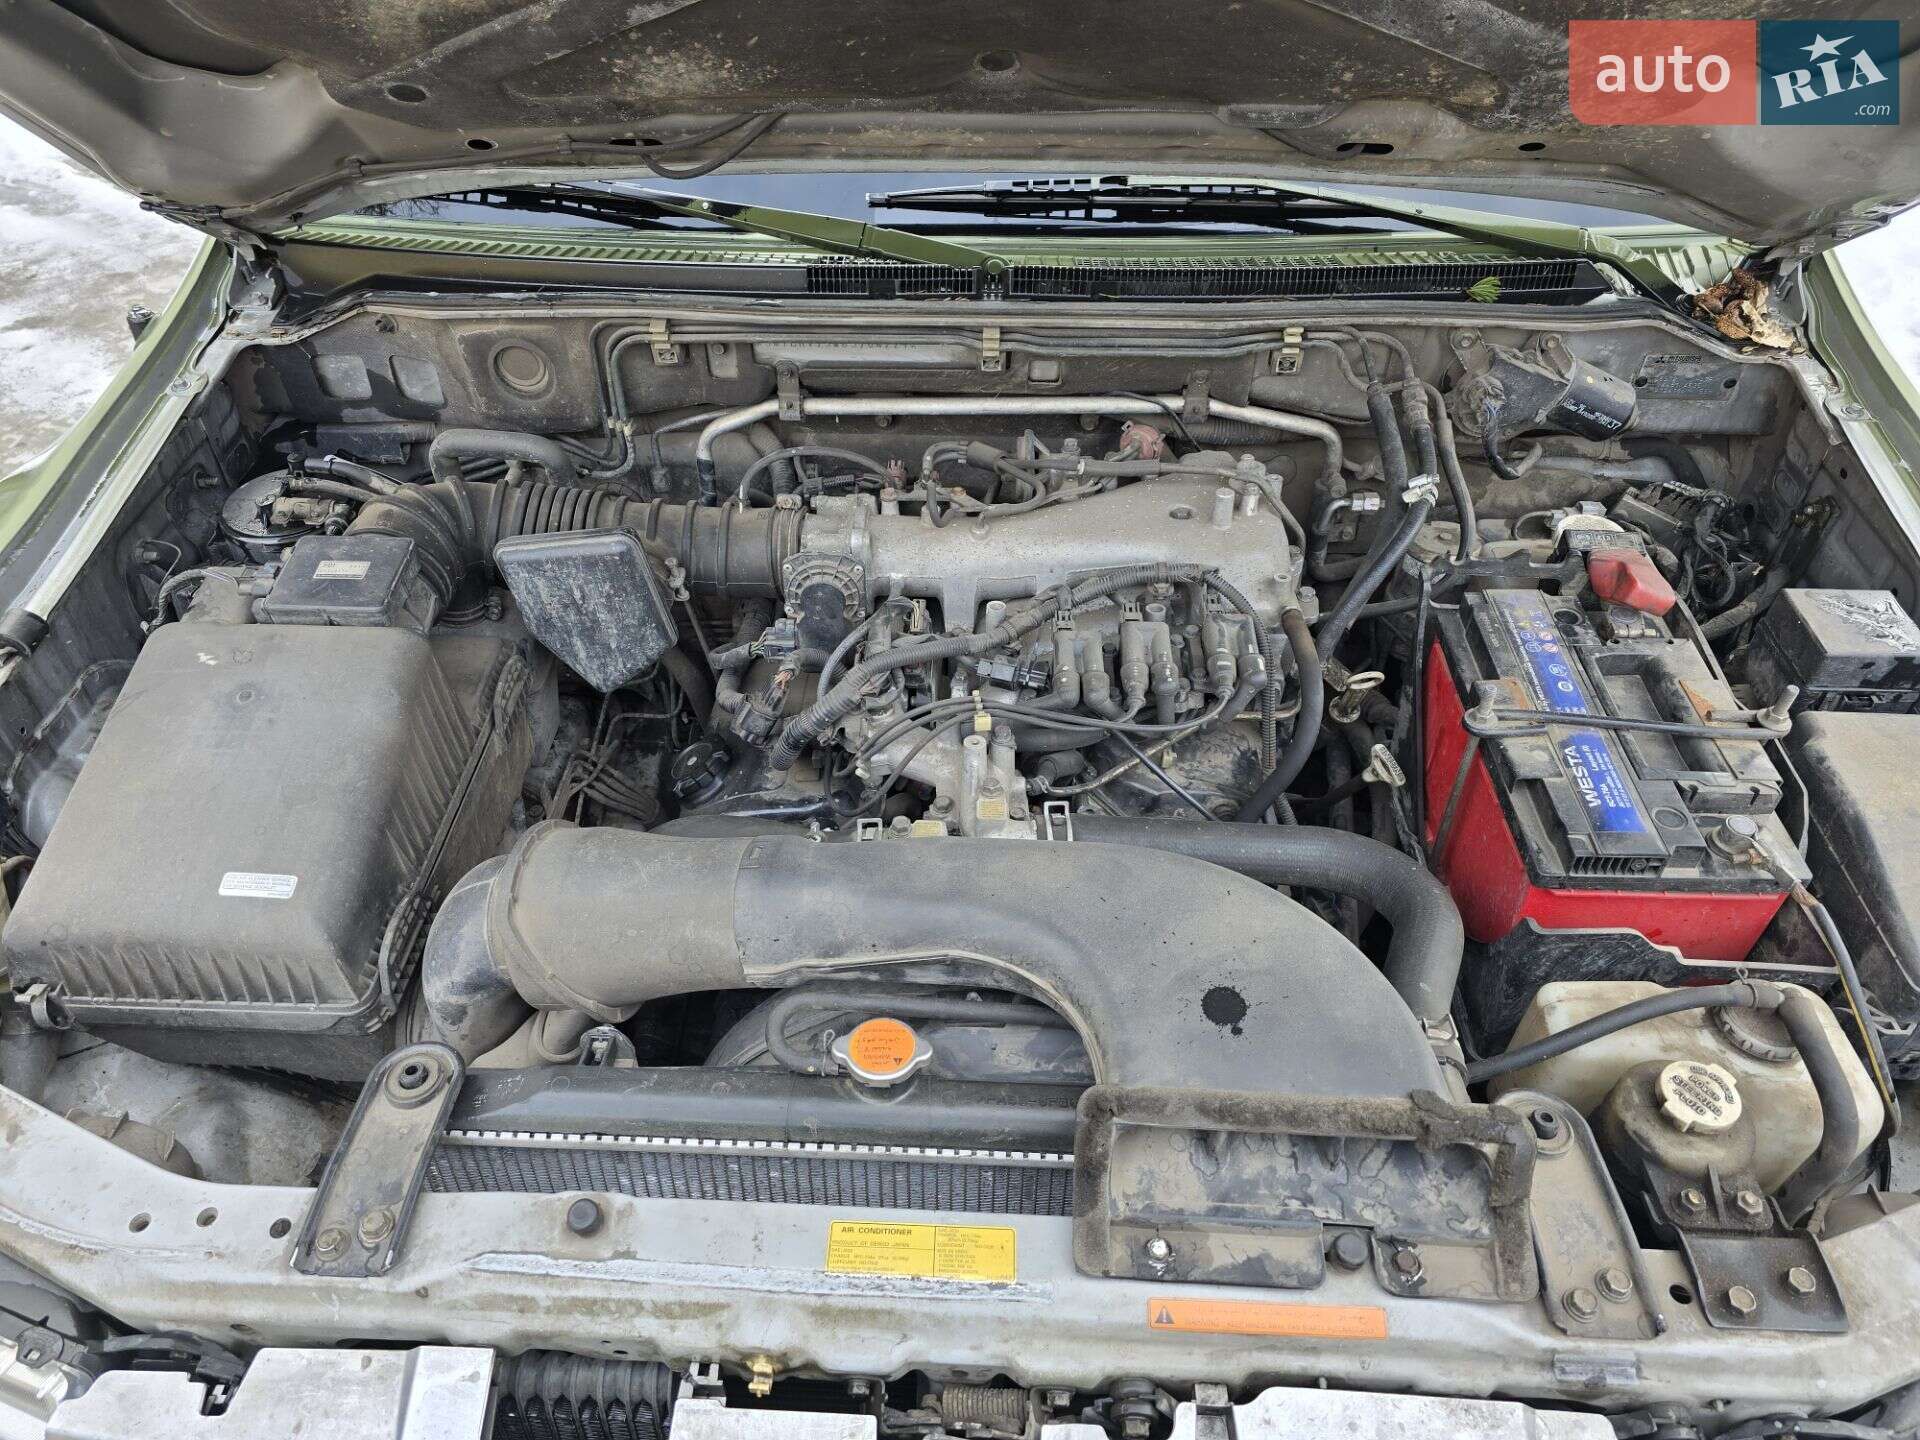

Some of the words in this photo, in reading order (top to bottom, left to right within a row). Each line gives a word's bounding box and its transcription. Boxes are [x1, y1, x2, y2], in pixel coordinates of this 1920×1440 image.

[1564, 745, 1601, 807] WESTA
[1671, 1074, 1723, 1117] STEERING
[1672, 1088, 1707, 1116] FLUID
[858, 1227, 912, 1236] CONDITIONER
